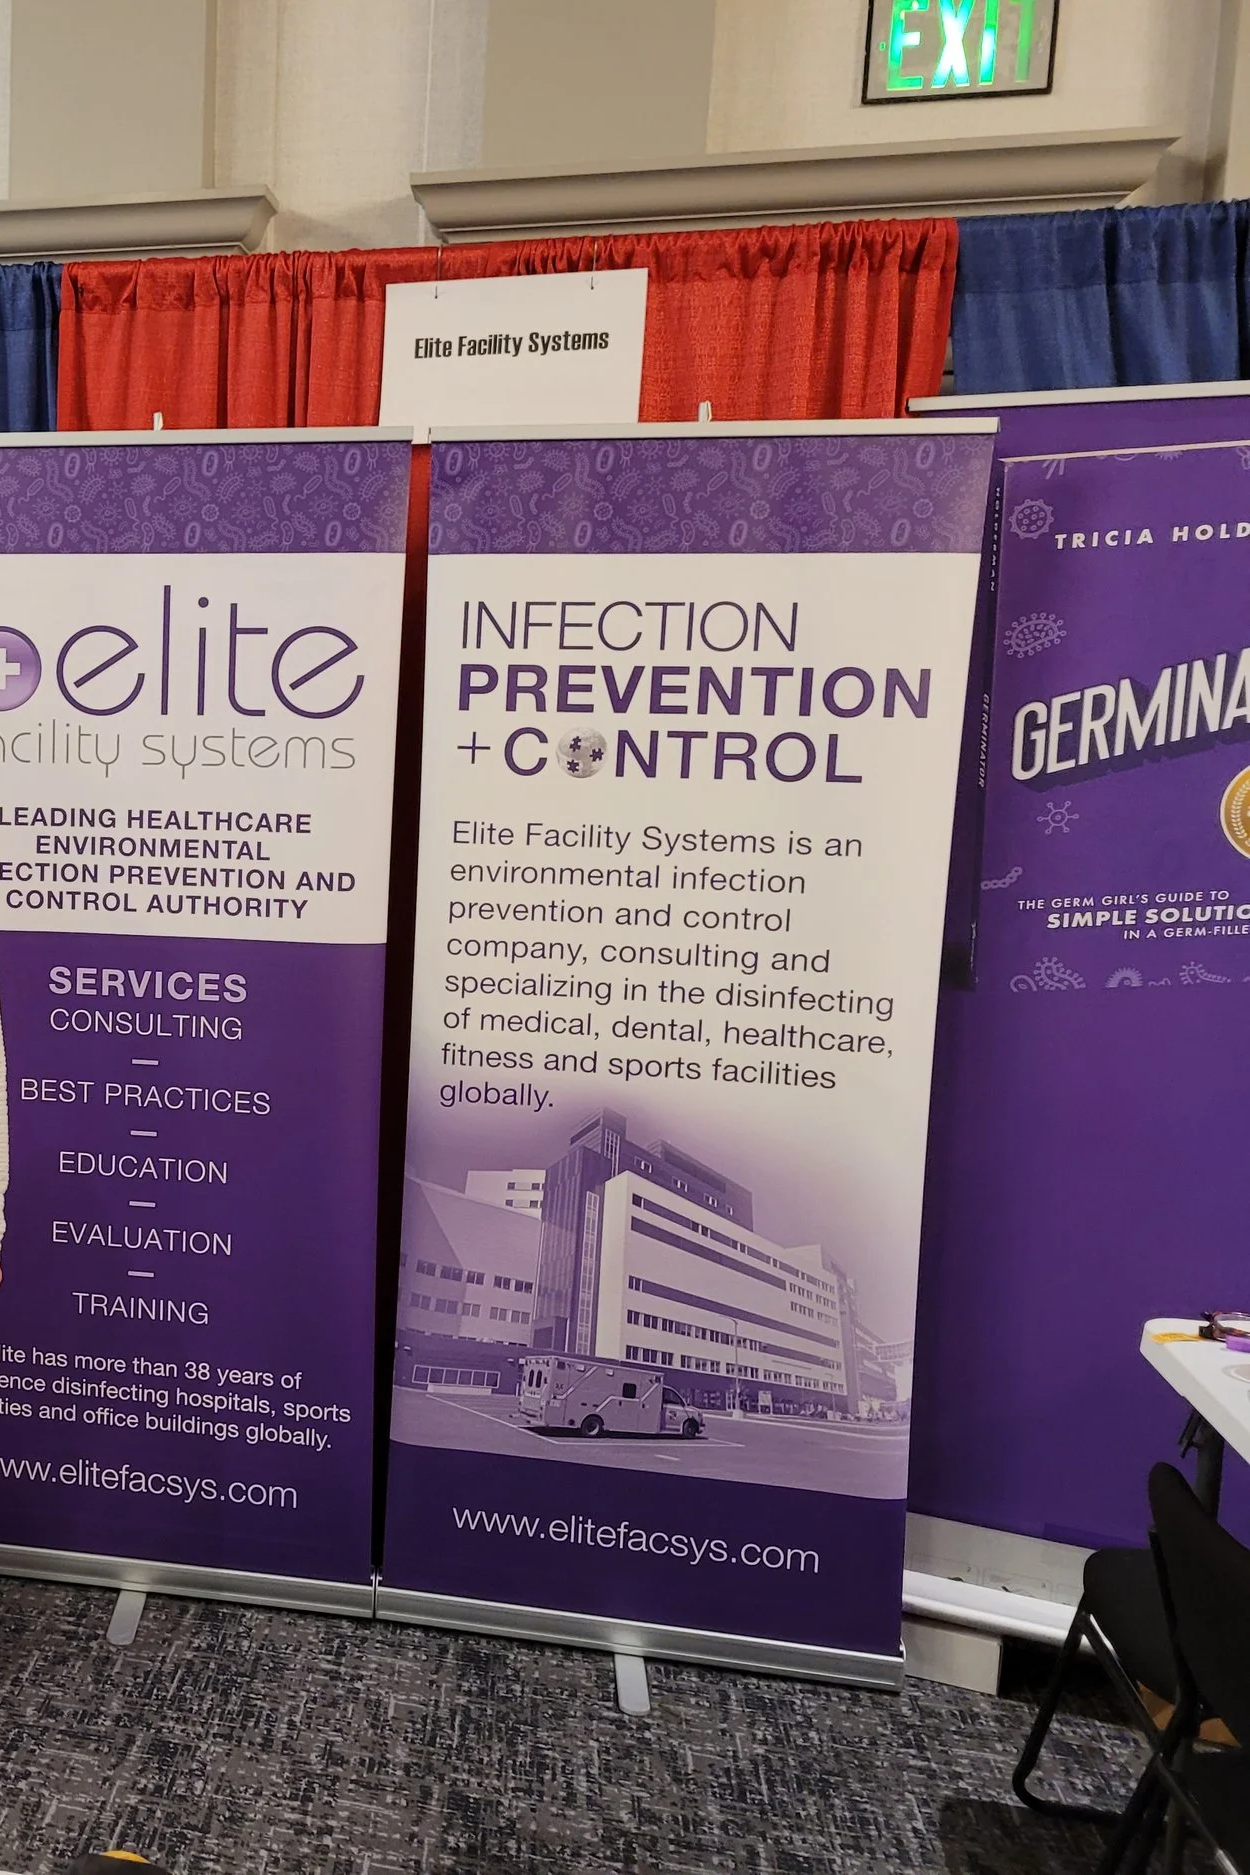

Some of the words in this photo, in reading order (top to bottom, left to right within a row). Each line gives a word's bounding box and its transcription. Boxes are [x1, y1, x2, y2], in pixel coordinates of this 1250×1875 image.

[886, 0, 1036, 90] EXIT
[414, 338, 452, 359] Elite
[458, 334, 523, 357] Facility
[528, 331, 610, 355] Systems
[1055, 528, 1153, 549] TRICIA
[1172, 522, 1250, 542] HOLD
[461, 600, 799, 653] INFECTION
[56, 584, 365, 719] elite
[458, 663, 932, 719] PREVENTION
[141, 727, 356, 779] systems
[126, 809, 312, 834] HEALTHCARE
[452, 819, 514, 846] Elite
[525, 823, 631, 852] Facility
[642, 826, 775, 857] Systems
[787, 830, 812, 856] is
[824, 836, 863, 858] an
[36, 835, 271, 861] ENVIRONMENTAL
[109, 864, 285, 890] PREVENTION
[295, 870, 356, 892] AND
[450, 859, 660, 889] environmental
[671, 865, 806, 894] infection
[5, 889, 137, 912] CONTROL
[146, 893, 308, 918] AUTHORITY
[448, 898, 603, 926] prevention
[614, 903, 671, 928] and
[683, 908, 791, 933] control
[1018, 900, 1045, 910] THE
[1051, 897, 1094, 908] GERM
[1102, 894, 1149, 906] GIRL'S
[1155, 891, 1203, 903] GUIDE
[1210, 890, 1230, 900] TO
[1047, 909, 1137, 928] SIMPLE
[1124, 930, 1140, 940] IN
[1147, 928, 1157, 939] A
[446, 938, 588, 966] company,
[600, 943, 759, 975] consulting
[771, 948, 830, 974] and
[48, 966, 247, 1003] SERVICES
[444, 972, 612, 1006] specializing
[623, 977, 647, 1002] in
[658, 980, 705, 1005] the
[715, 982, 895, 1022] disinfecting
[50, 1008, 242, 1041] CONSULTING
[443, 1008, 471, 1030] of
[480, 1010, 600, 1039] medical,
[611, 1016, 712, 1046] dental,
[723, 1019, 895, 1058] healthcare,
[441, 1043, 533, 1069] fitness
[543, 1048, 598, 1074] and
[607, 1055, 701, 1081] sports
[711, 1057, 837, 1089] facilities
[20, 1078, 94, 1104] BEST
[105, 1082, 271, 1115] PRACTICES
[439, 1080, 554, 1112] globally.
[59, 1151, 228, 1184] EDUCATION
[52, 1221, 232, 1256] EVALUATION
[72, 1292, 209, 1325] TRAINING
[32, 1347, 68, 1367] has
[74, 1354, 126, 1374] more
[132, 1357, 178, 1378] than
[184, 1361, 210, 1381] 38
[217, 1367, 273, 1389] years
[280, 1370, 302, 1389] of
[52, 1377, 168, 1408] disinfecting
[176, 1387, 276, 1418] hospitals,
[283, 1399, 351, 1424] sports
[39, 1403, 76, 1422] and
[83, 1407, 139, 1429] office
[146, 1412, 239, 1441] buildings
[246, 1421, 332, 1452] globally.
[453, 1505, 820, 1575] www.elitefacsys.com
